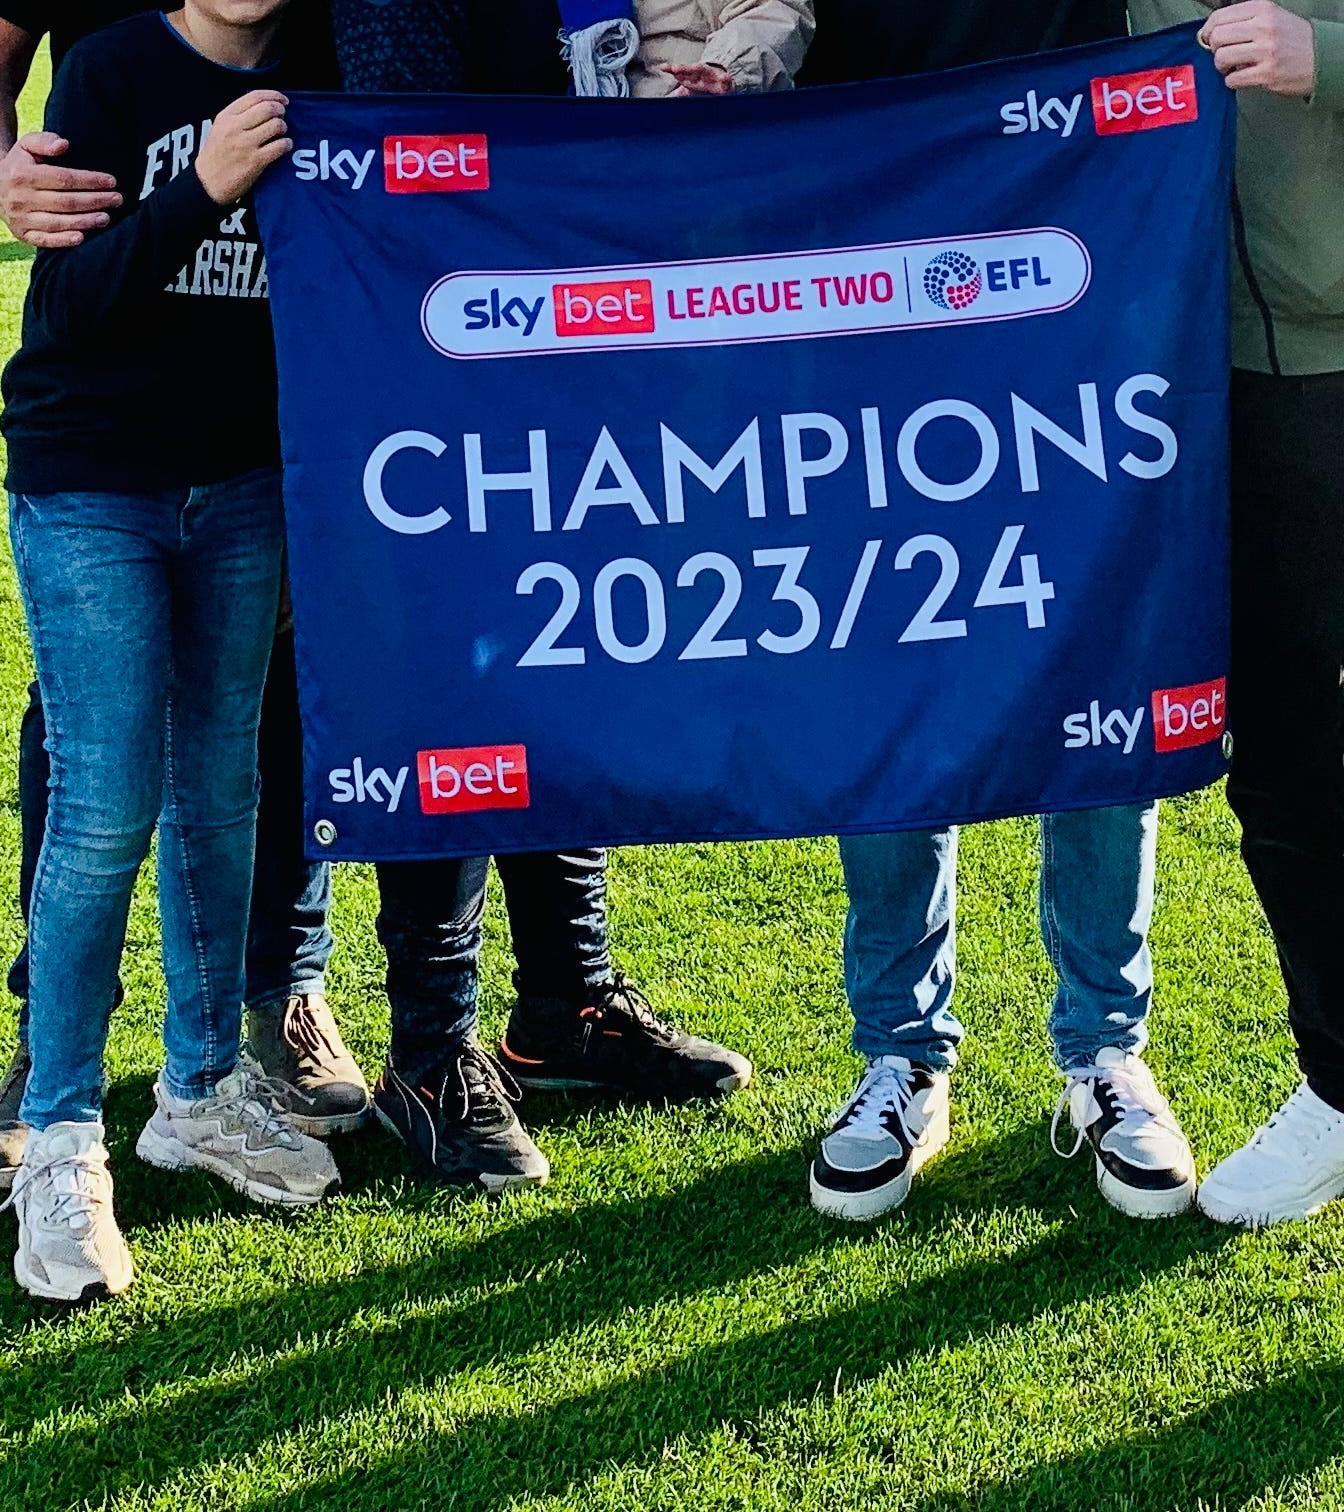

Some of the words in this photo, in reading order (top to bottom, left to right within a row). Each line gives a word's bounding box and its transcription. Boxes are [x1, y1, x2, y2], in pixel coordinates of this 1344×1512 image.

[999, 88, 1083, 138] sky
[1102, 73, 1187, 125] bet
[291, 139, 377, 191] sky
[394, 138, 481, 183] bet
[462, 285, 545, 337] sky
[562, 282, 646, 327] bet
[666, 277, 801, 321] LEAGUE
[809, 271, 895, 311] TWO
[985, 257, 1051, 292] EFL
[360, 372, 1179, 535] CHAMPIONS
[514, 524, 1056, 668] 2023/24
[1062, 702, 1145, 754] sky
[1161, 689, 1222, 735] bet
[328, 755, 410, 814] sky
[427, 752, 519, 800] bet
